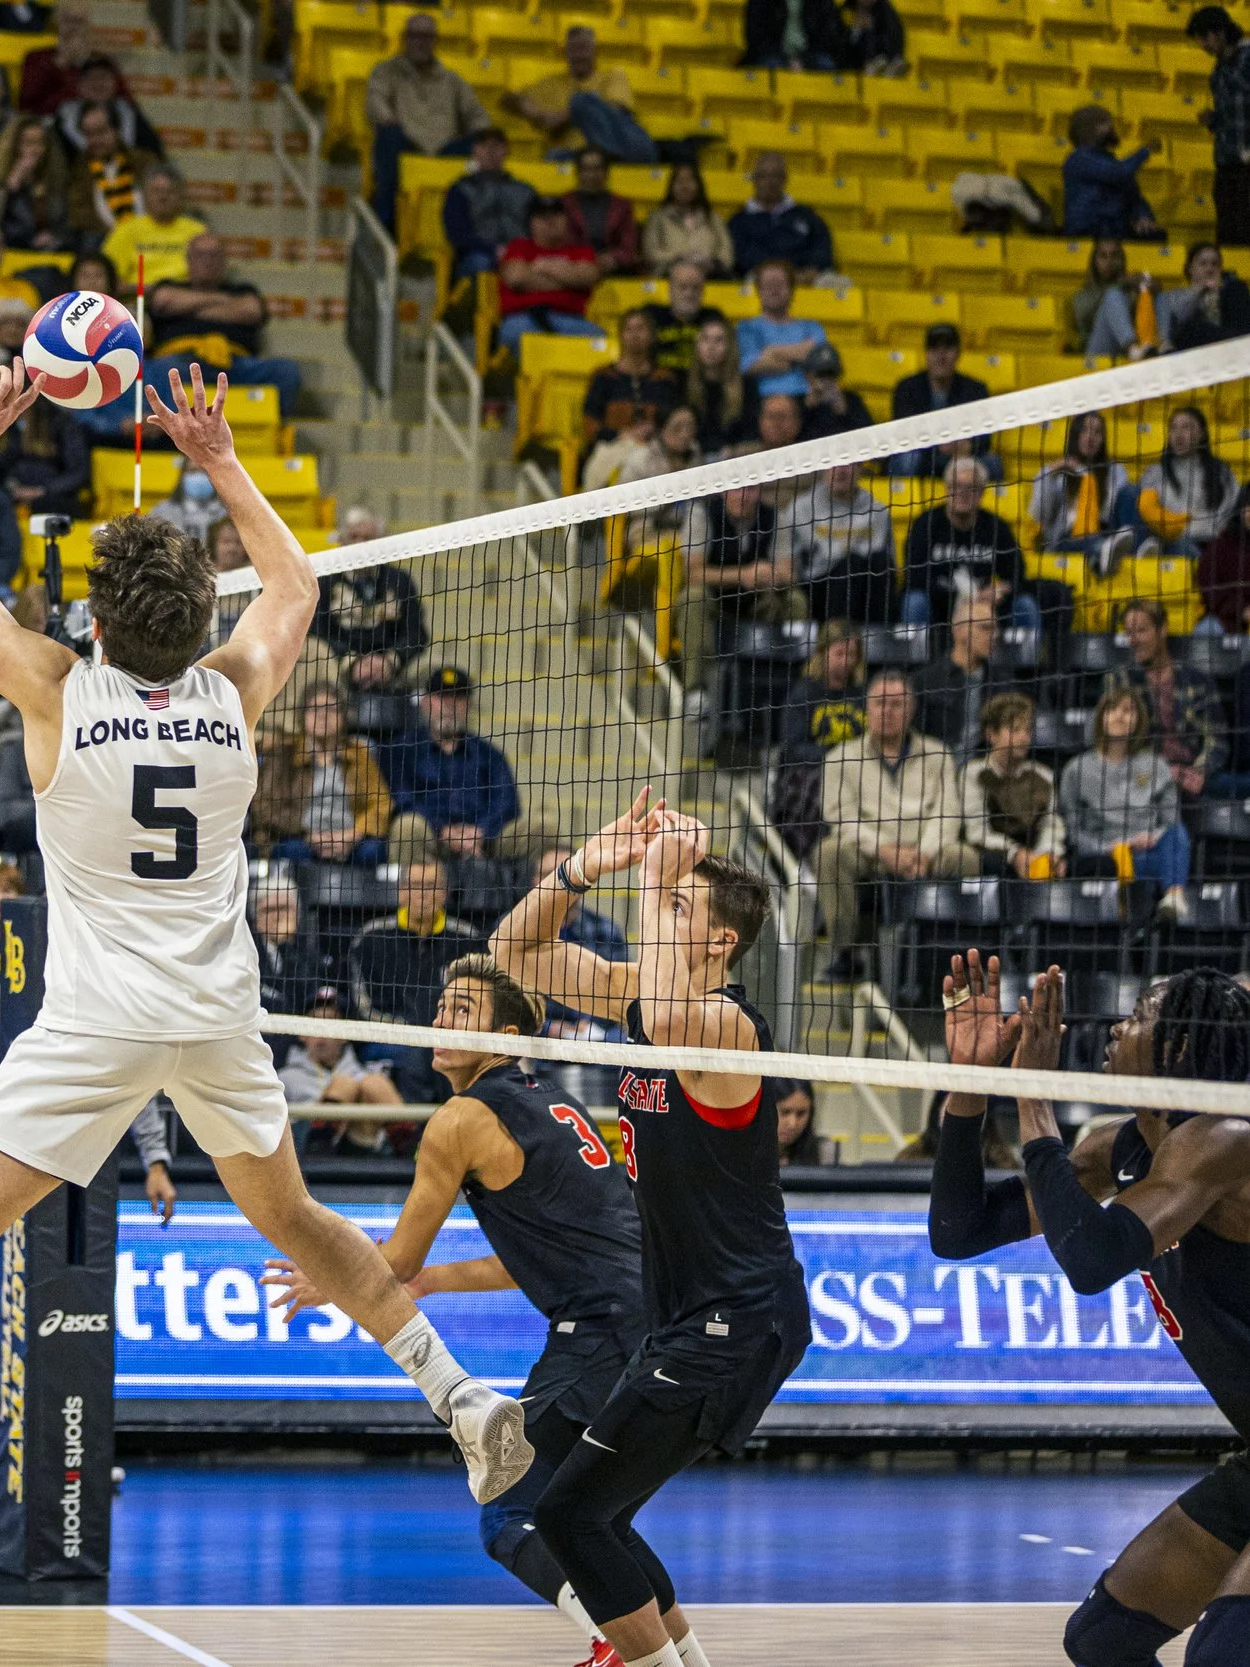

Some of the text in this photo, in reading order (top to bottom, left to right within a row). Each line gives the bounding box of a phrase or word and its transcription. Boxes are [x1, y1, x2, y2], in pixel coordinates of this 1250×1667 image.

[66, 297, 99, 326] NCAA
[75, 717, 242, 751] LONG BEACH
[131, 764, 198, 880] 5
[549, 1103, 610, 1170] 3
[61, 1313, 109, 1333] asics
[6, 1217, 26, 1504] EACH STATE
[59, 1395, 85, 1559] sports imports
